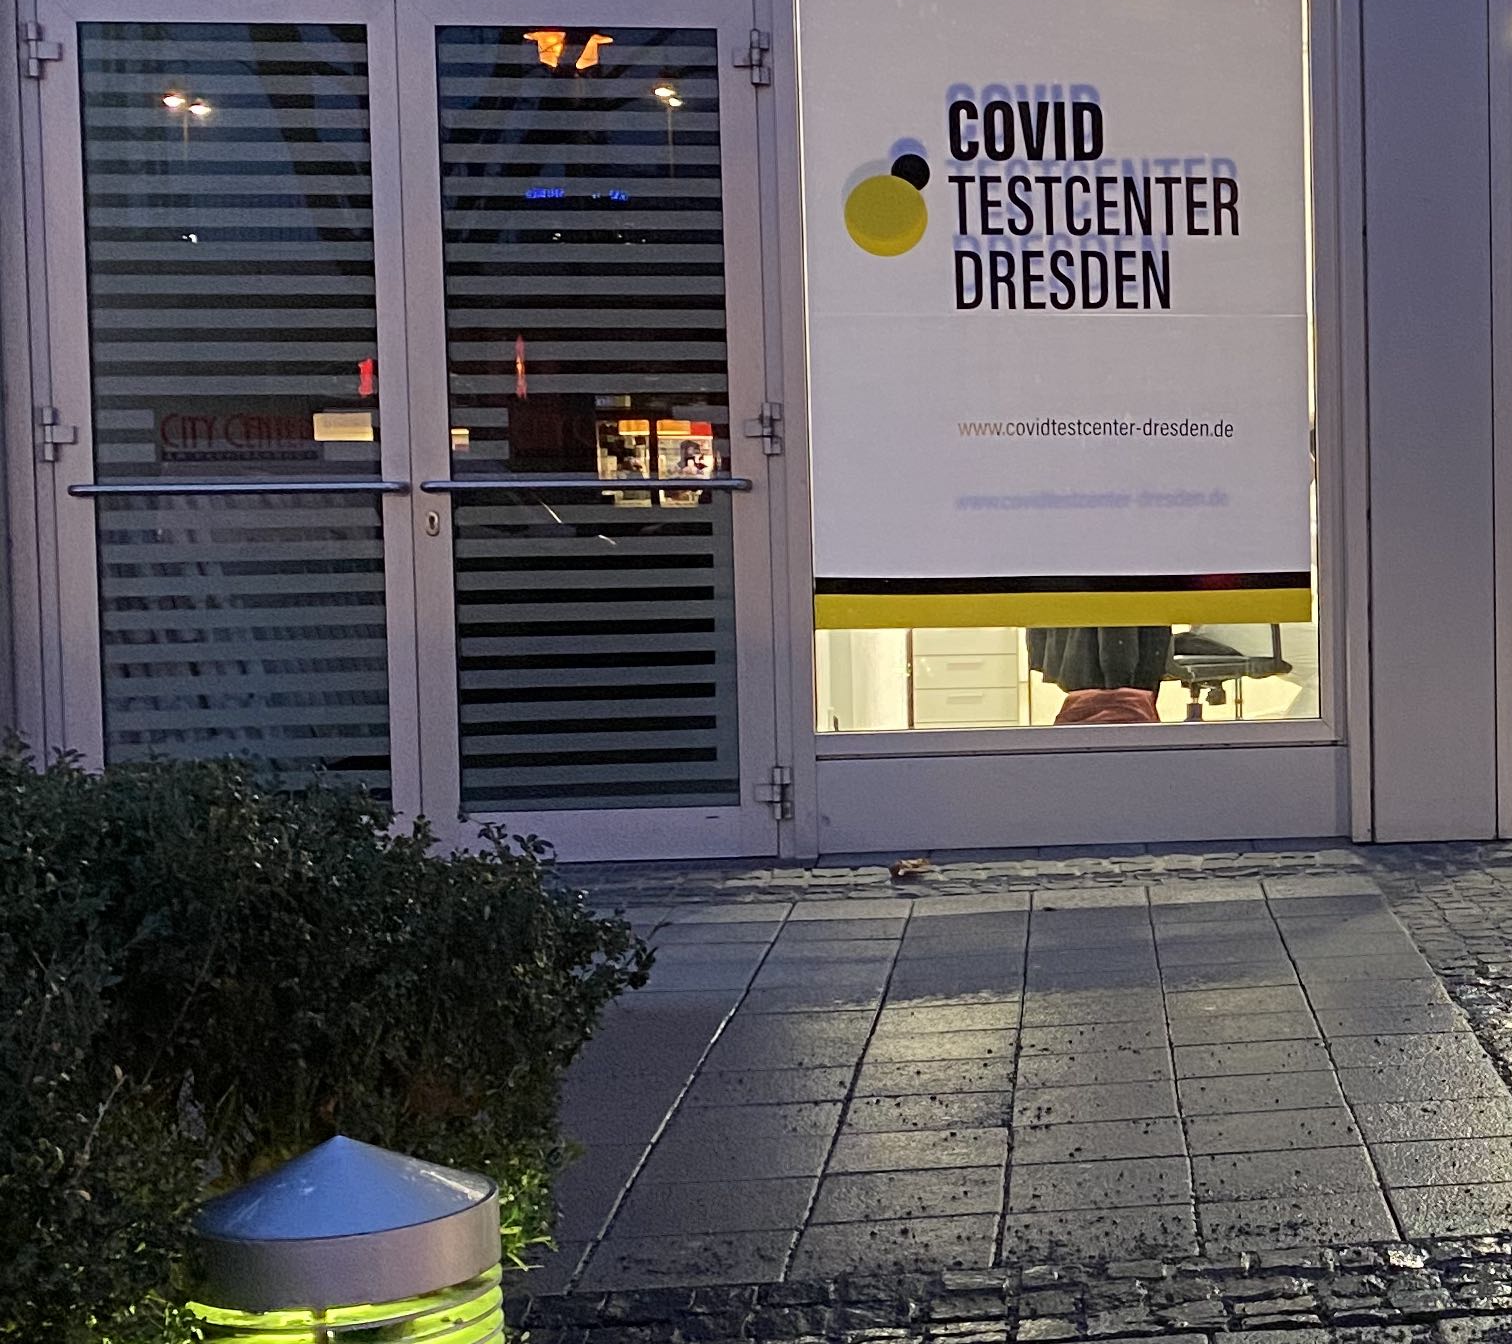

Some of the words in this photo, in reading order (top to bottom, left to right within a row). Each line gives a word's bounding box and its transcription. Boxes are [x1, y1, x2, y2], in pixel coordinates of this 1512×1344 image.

[948, 99, 1104, 162] COVID
[948, 175, 1240, 237] TESTCENTER
[955, 249, 1172, 310] DRESDEN
[160, 413, 214, 449] CITY
[957, 417, 1234, 439] www.covidtestcenter-dresden.de
